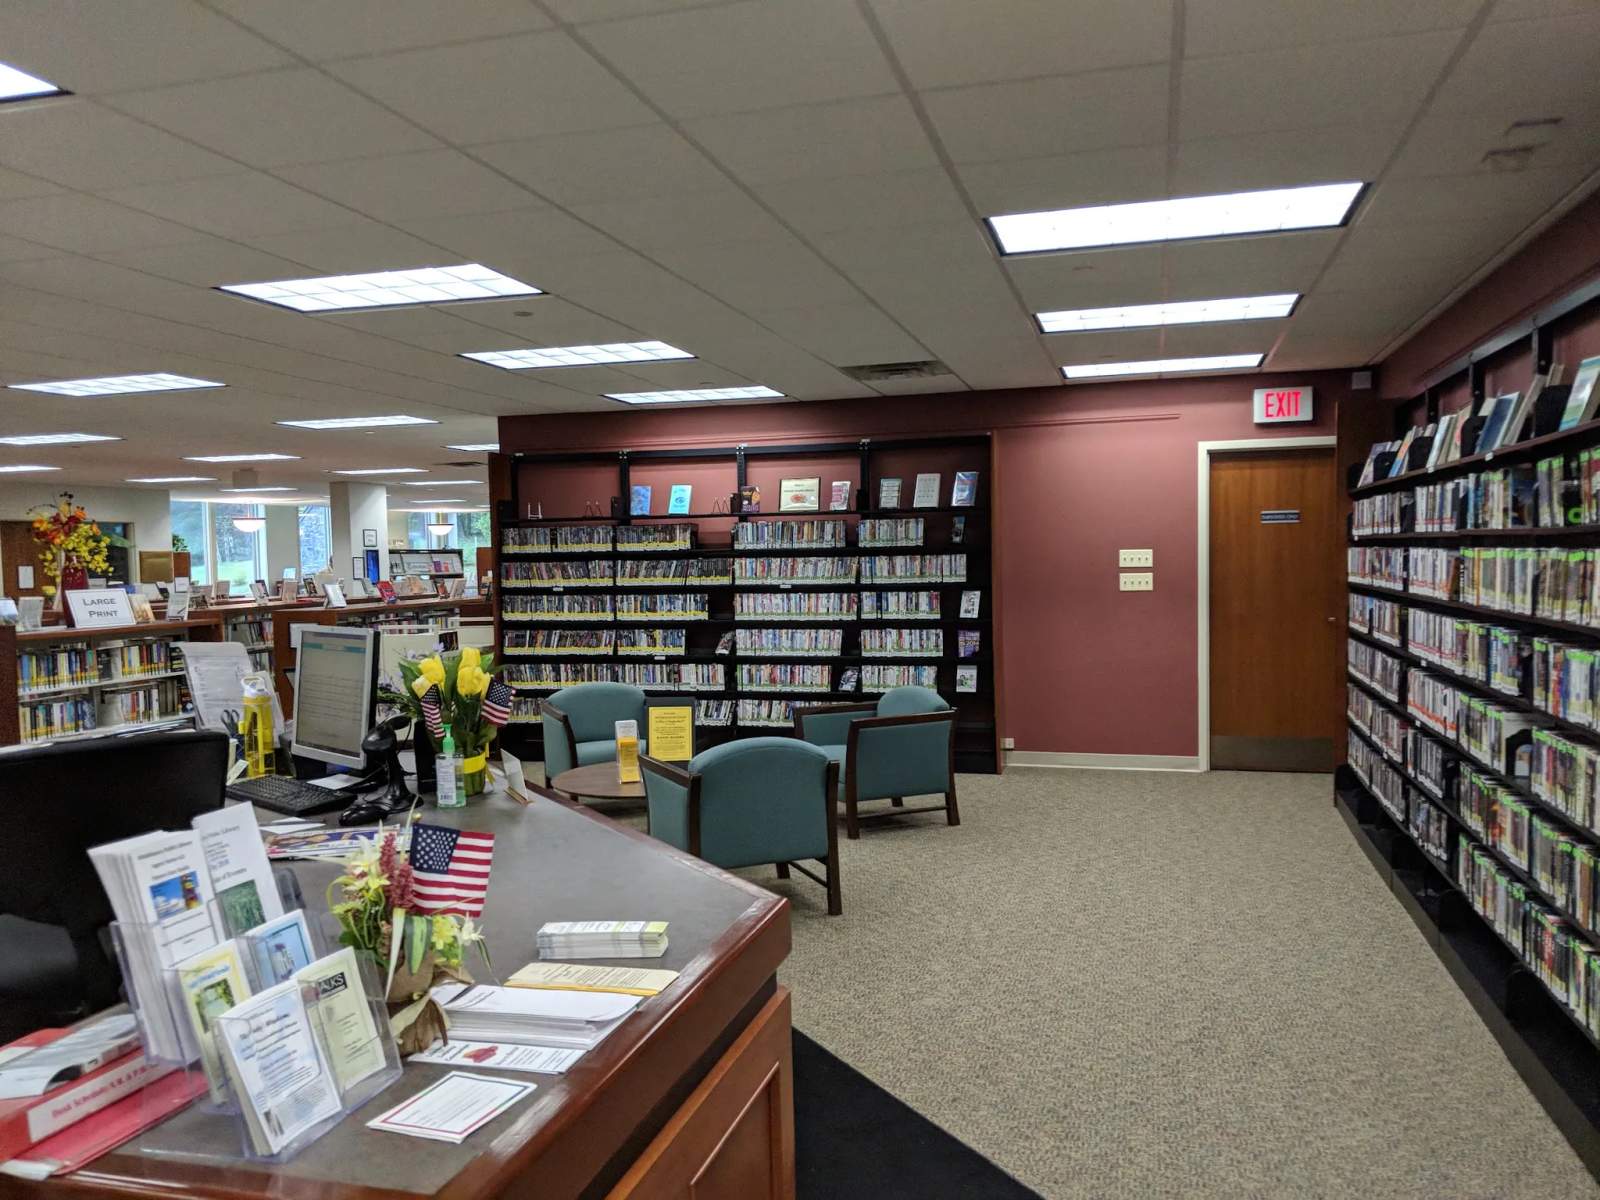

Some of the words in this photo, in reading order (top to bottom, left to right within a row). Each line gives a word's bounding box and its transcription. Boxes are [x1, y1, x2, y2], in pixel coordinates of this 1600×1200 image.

[1264, 391, 1301, 418] EXIT
[83, 598, 117, 606] LARGE
[88, 610, 119, 618] PRINT
